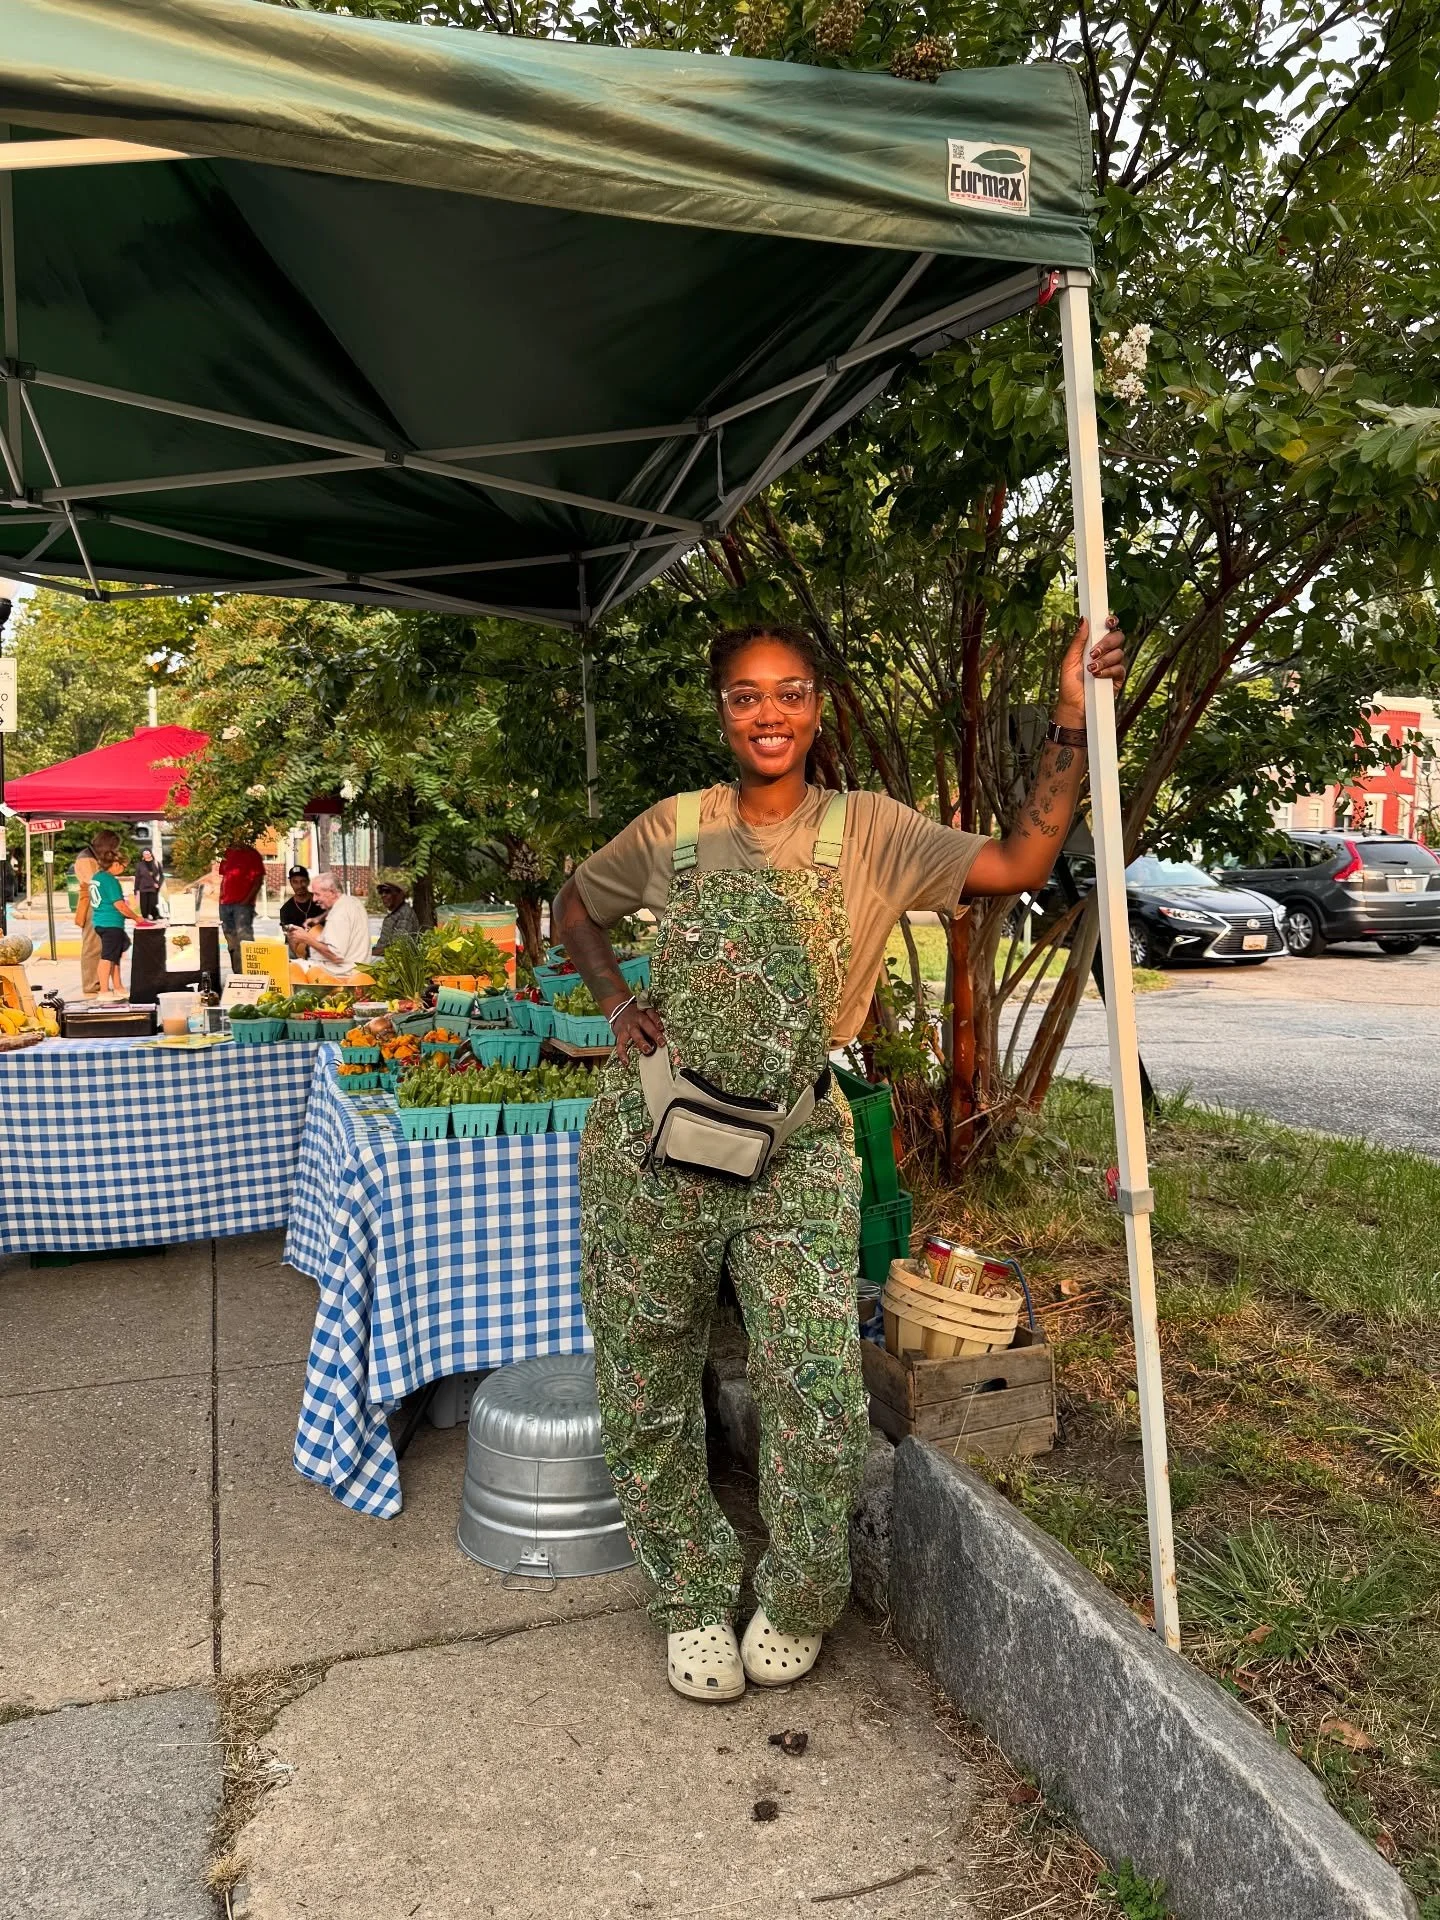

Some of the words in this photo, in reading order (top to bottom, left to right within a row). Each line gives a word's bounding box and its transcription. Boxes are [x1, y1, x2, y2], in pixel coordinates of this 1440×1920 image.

[951, 163, 1023, 202] Eurmax
[31, 823, 42, 832] ALL
[45, 820, 60, 830] WAY
